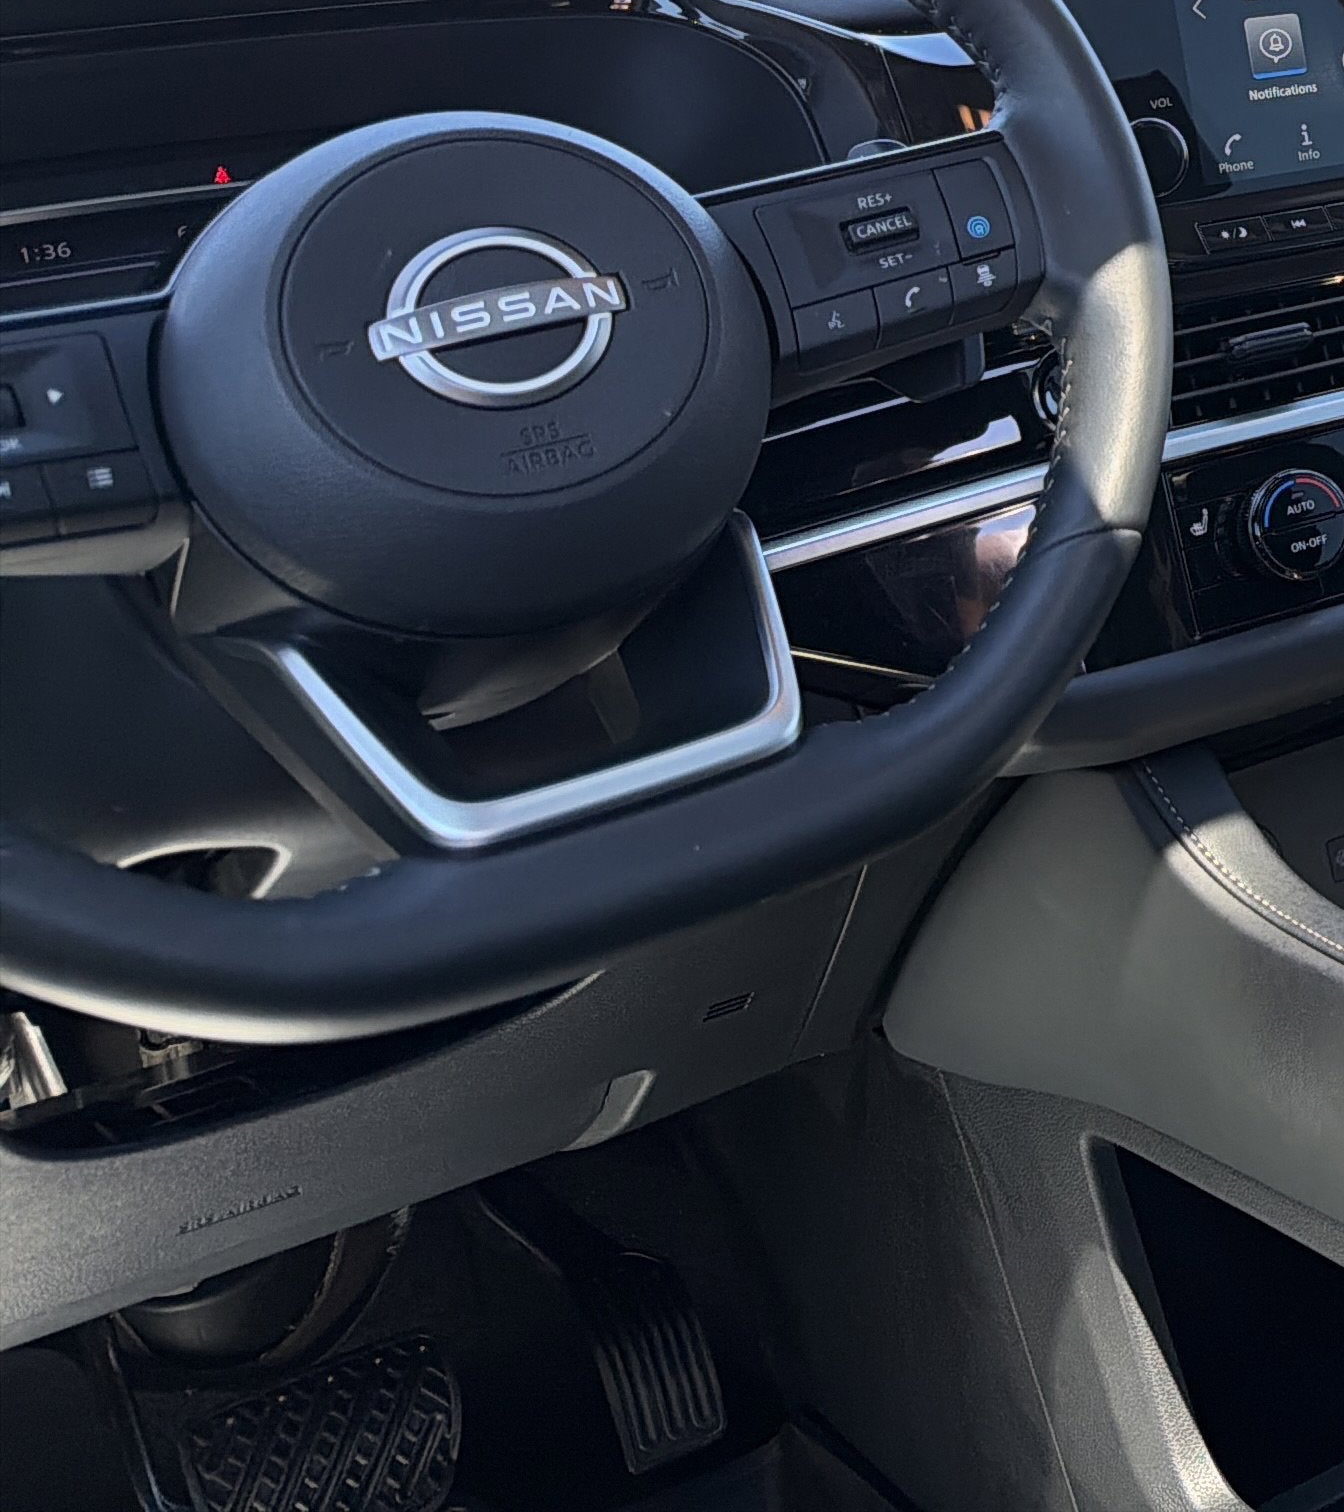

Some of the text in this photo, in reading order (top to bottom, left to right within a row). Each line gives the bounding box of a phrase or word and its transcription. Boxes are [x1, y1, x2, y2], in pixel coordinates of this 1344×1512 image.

[1248, 83, 1318, 101] Notifications
[1149, 97, 1174, 110] VOL
[1297, 149, 1321, 162] Info
[1218, 159, 1255, 175] Phone
[857, 192, 893, 210] RES+
[856, 215, 913, 239] CANCEL
[20, 241, 72, 265] 1:36
[378, 278, 622, 352] NISSAN
[520, 420, 560, 446] SRS
[508, 439, 595, 475] AIRBAG
[1287, 499, 1316, 517] AUTO
